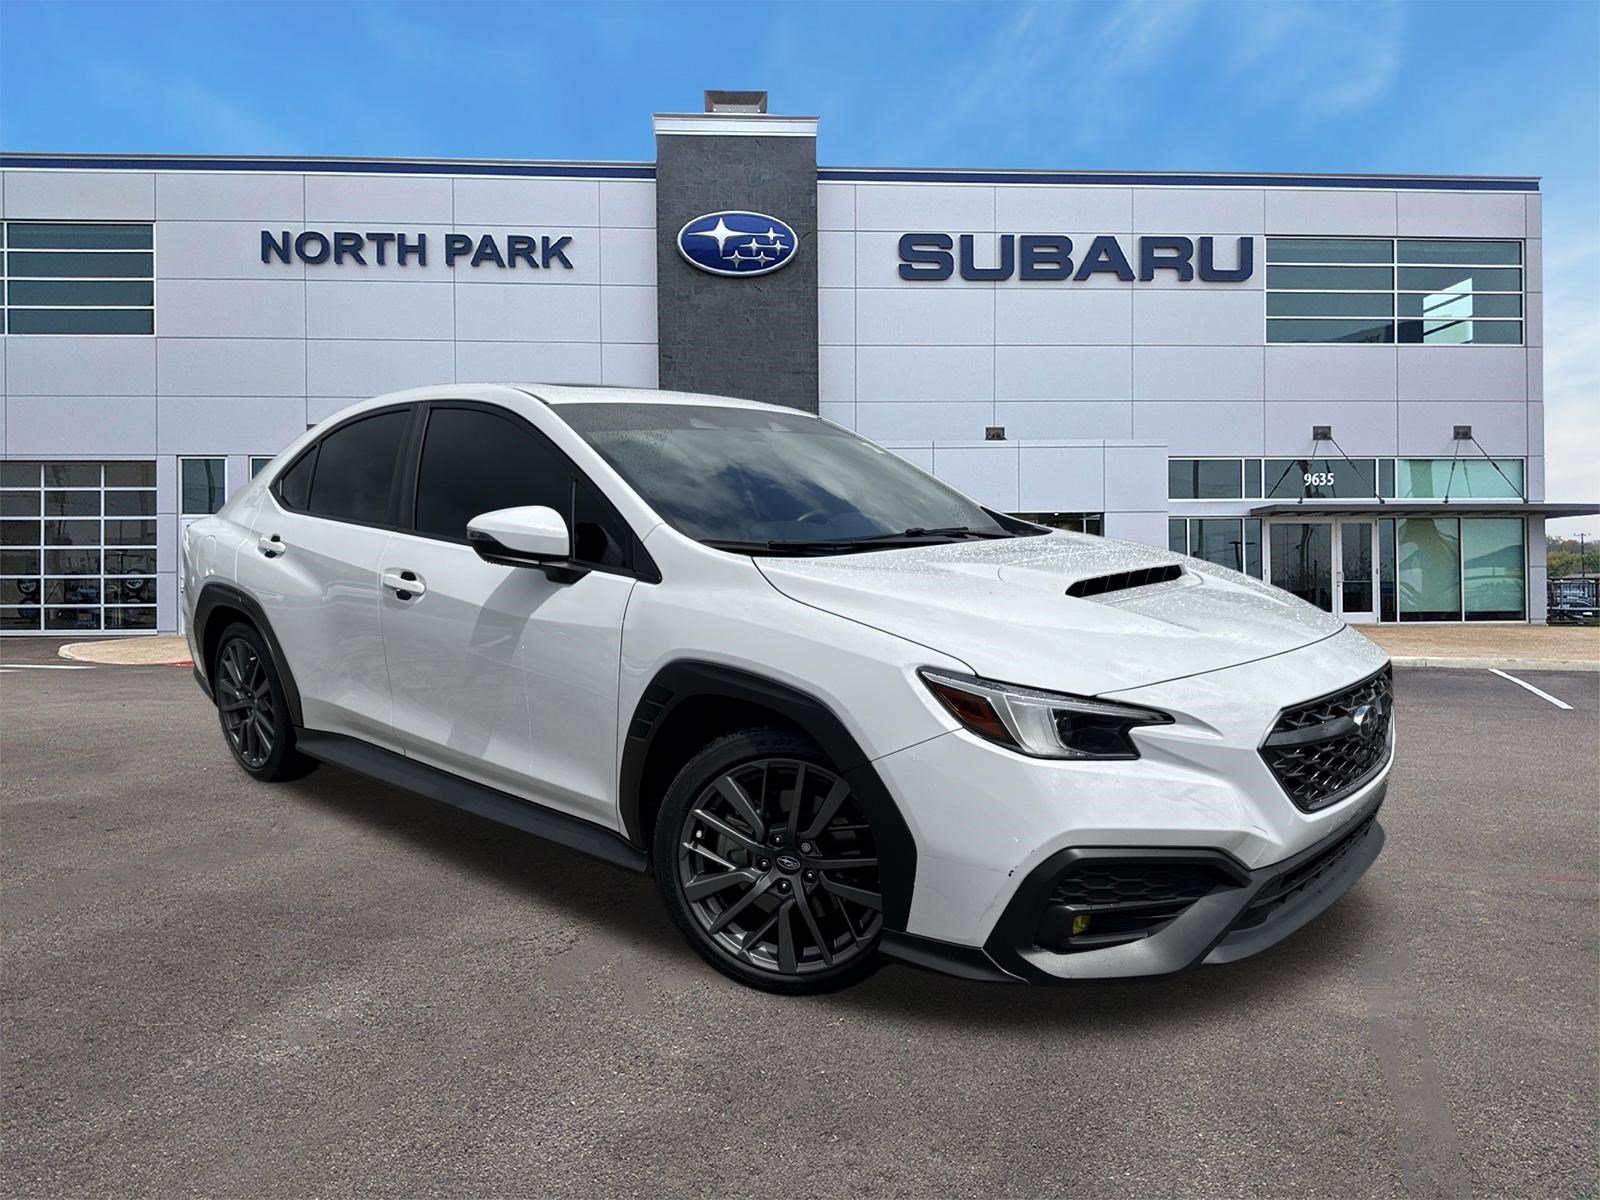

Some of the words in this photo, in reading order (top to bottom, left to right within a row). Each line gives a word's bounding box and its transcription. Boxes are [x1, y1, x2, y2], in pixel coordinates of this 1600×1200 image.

[260, 230, 427, 267] NORTH
[444, 233, 574, 269] PARK
[898, 233, 1254, 283] SUBARU
[1303, 472, 1335, 487] 9635
